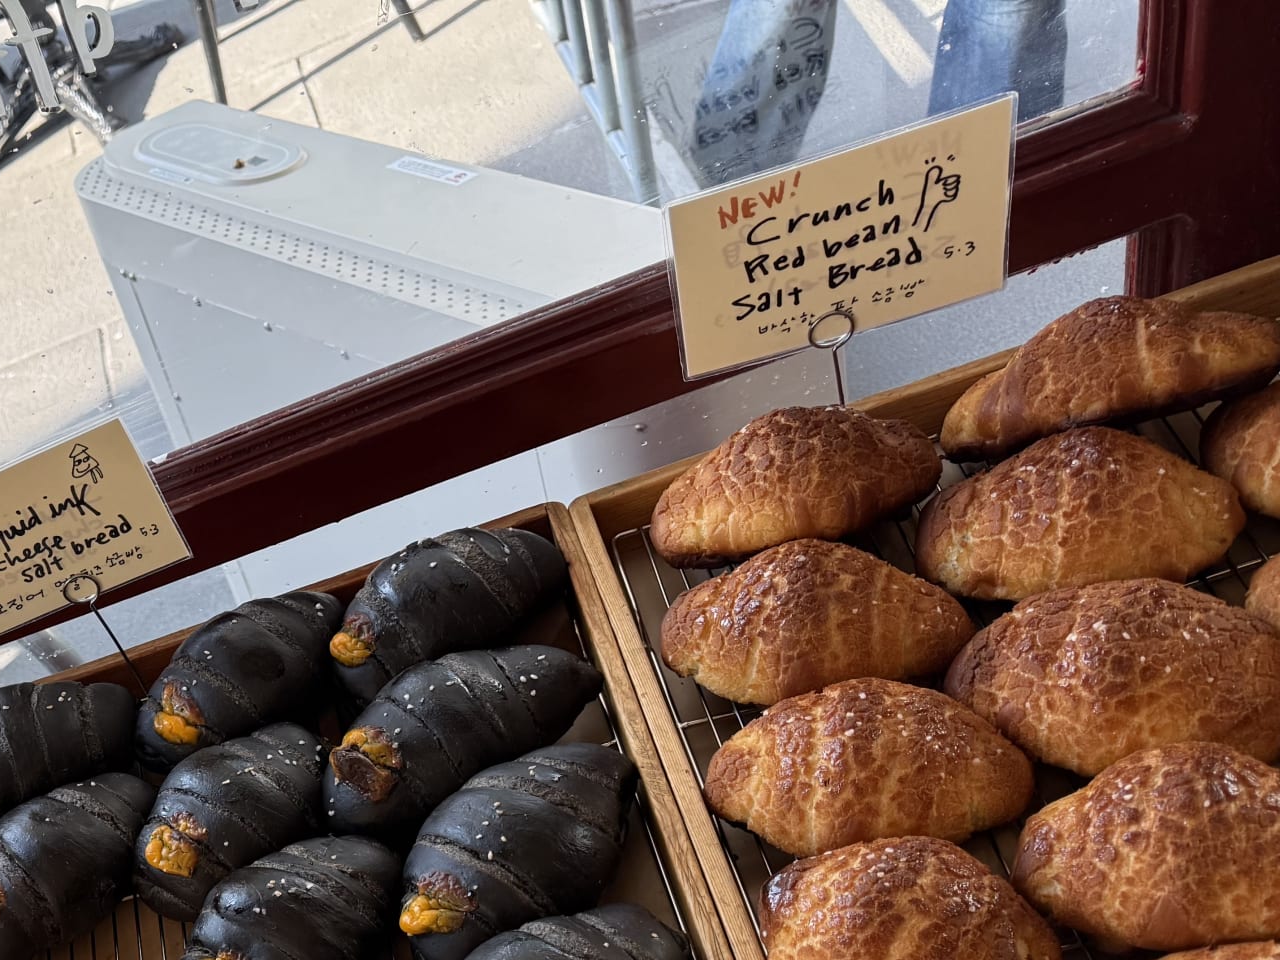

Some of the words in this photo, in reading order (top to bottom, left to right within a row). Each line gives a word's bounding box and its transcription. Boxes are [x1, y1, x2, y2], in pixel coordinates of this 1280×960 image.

[718, 171, 801, 229] NEW!
[747, 180, 895, 245] Crunch
[732, 287, 803, 321] Salt
[828, 237, 923, 289] Bread
[744, 246, 805, 283] Red
[823, 215, 900, 259] bean
[21, 556, 64, 583] salt
[70, 515, 132, 556] bread
